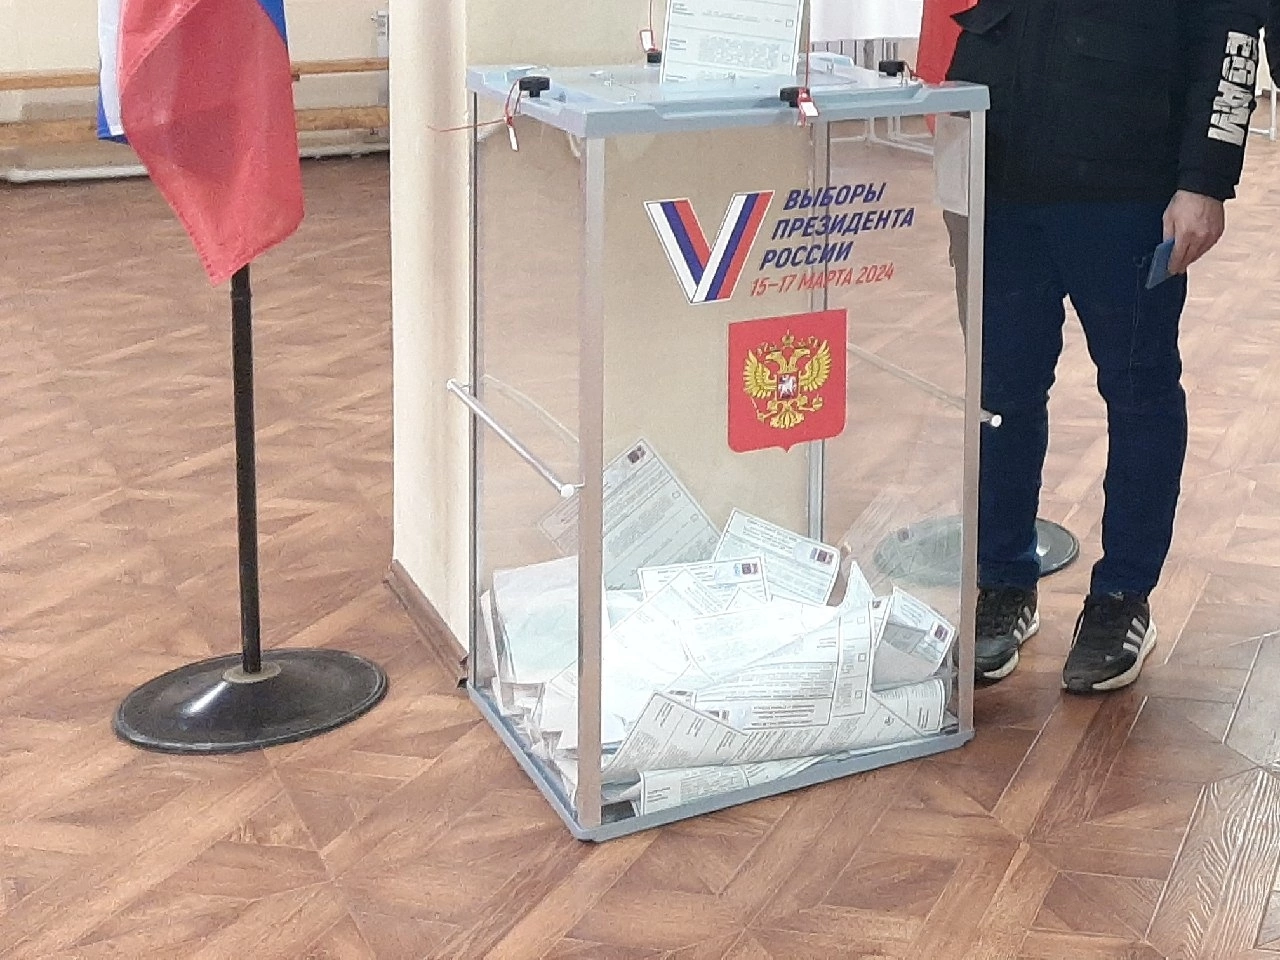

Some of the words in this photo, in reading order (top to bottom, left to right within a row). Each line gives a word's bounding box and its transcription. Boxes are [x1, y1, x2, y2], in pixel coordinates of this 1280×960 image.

[783, 182, 887, 211] ВЫБОРЫ
[771, 207, 915, 240] ПРЕЗИДЕНТА
[759, 241, 854, 271] РОССИИ
[799, 270, 853, 290] МАРТА
[855, 262, 896, 287] 2024
